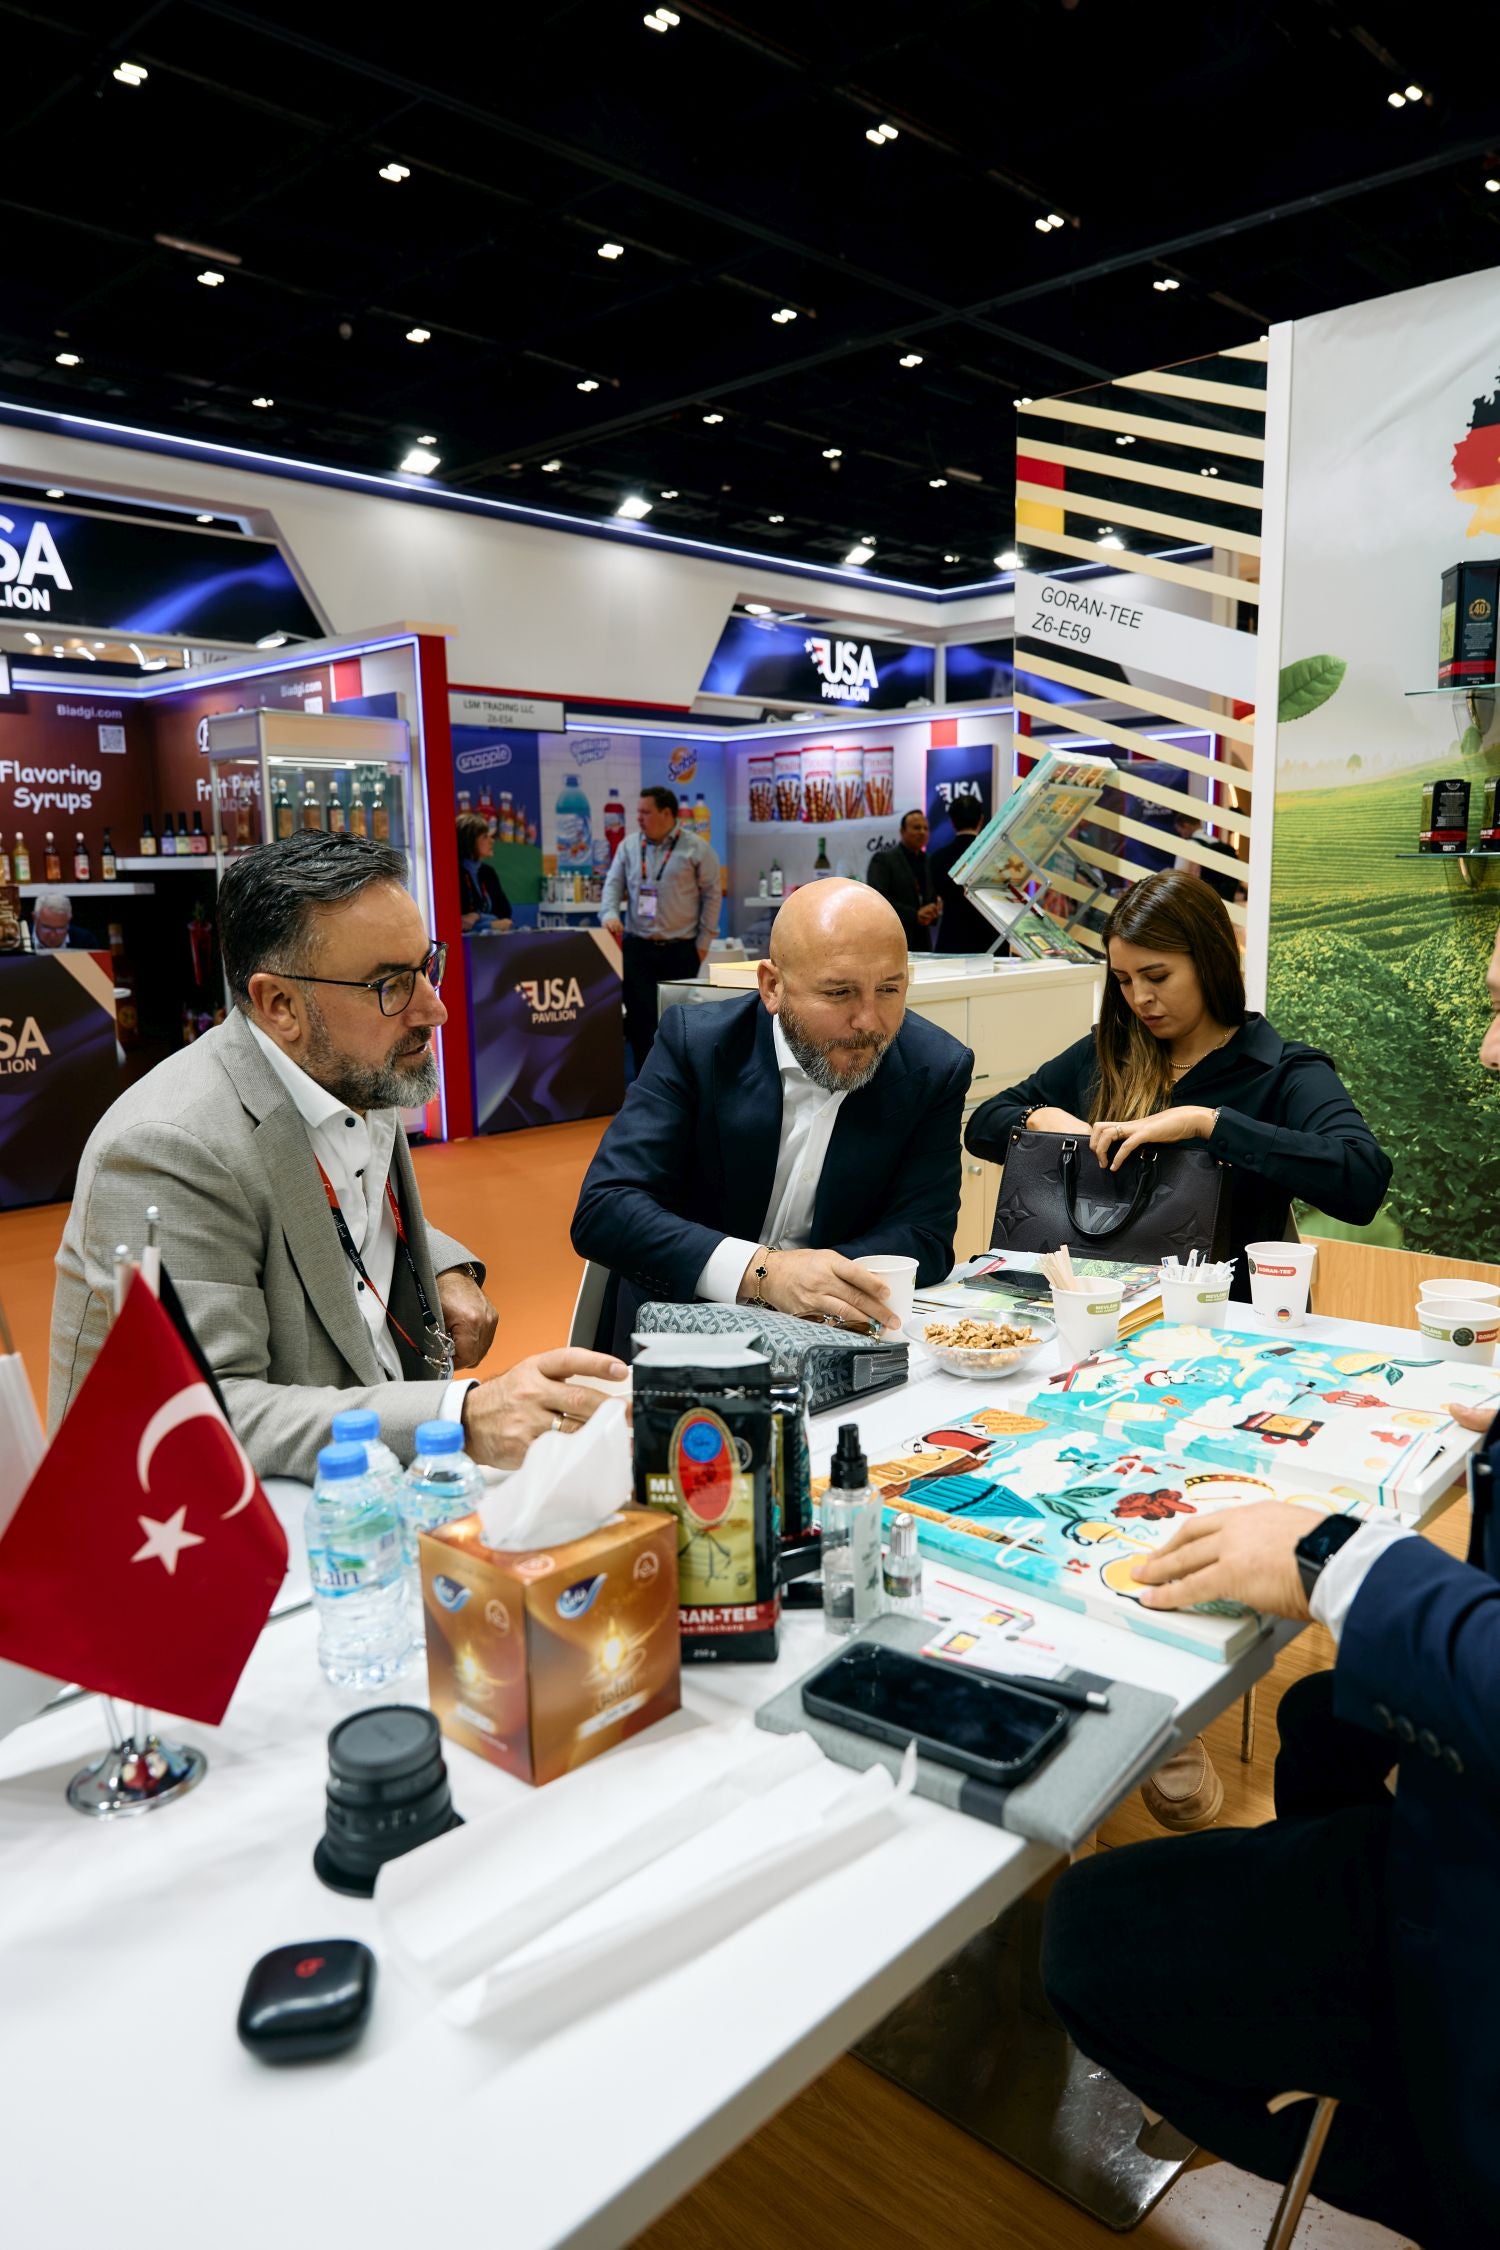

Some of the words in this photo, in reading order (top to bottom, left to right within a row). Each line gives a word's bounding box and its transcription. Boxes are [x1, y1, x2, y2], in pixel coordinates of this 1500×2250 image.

[1041, 586, 1144, 629] GORAN-TEE
[1473, 603, 1486, 615] 40
[1032, 612, 1091, 644] Z6-E59
[811, 636, 880, 688] USA
[821, 682, 870, 702] PAVILION
[56, 704, 123, 719] Biadgi.com
[464, 700, 481, 711] LSM
[483, 702, 519, 713] TRADING
[521, 704, 534, 714] LLC
[459, 746, 508, 770] snapple
[0, 760, 102, 791] Flavoring
[13, 787, 93, 815] Syrups
[520, 977, 585, 1011] USA
[532, 1009, 577, 1024] PAVILION
